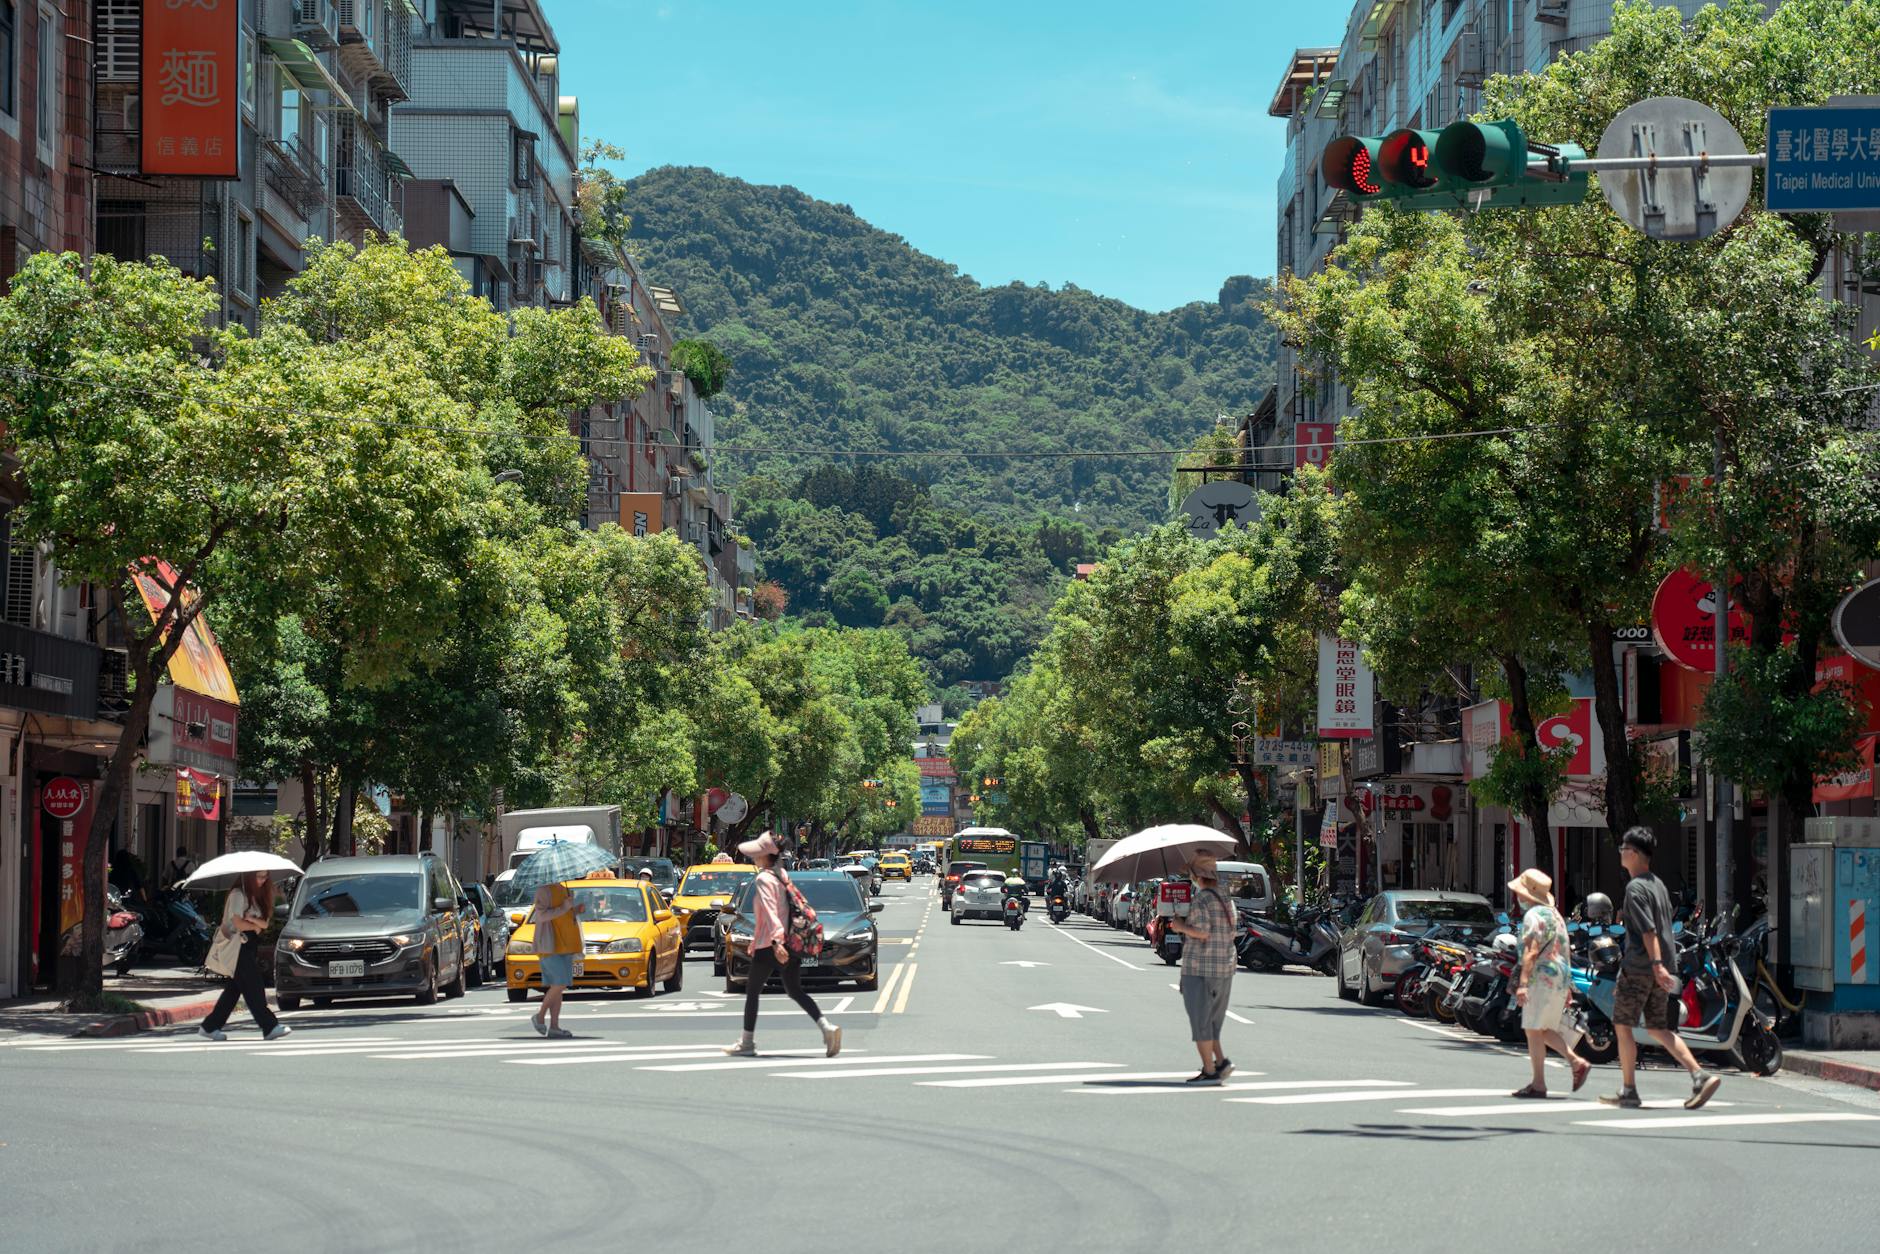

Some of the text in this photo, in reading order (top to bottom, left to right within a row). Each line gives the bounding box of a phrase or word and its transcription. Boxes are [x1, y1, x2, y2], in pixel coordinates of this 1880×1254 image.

[157, 136, 222, 156] 信義店
[1775, 128, 1880, 162] 臺北醫學大學
[1775, 173, 1808, 193] Taipei
[1812, 172, 1853, 189] Medical
